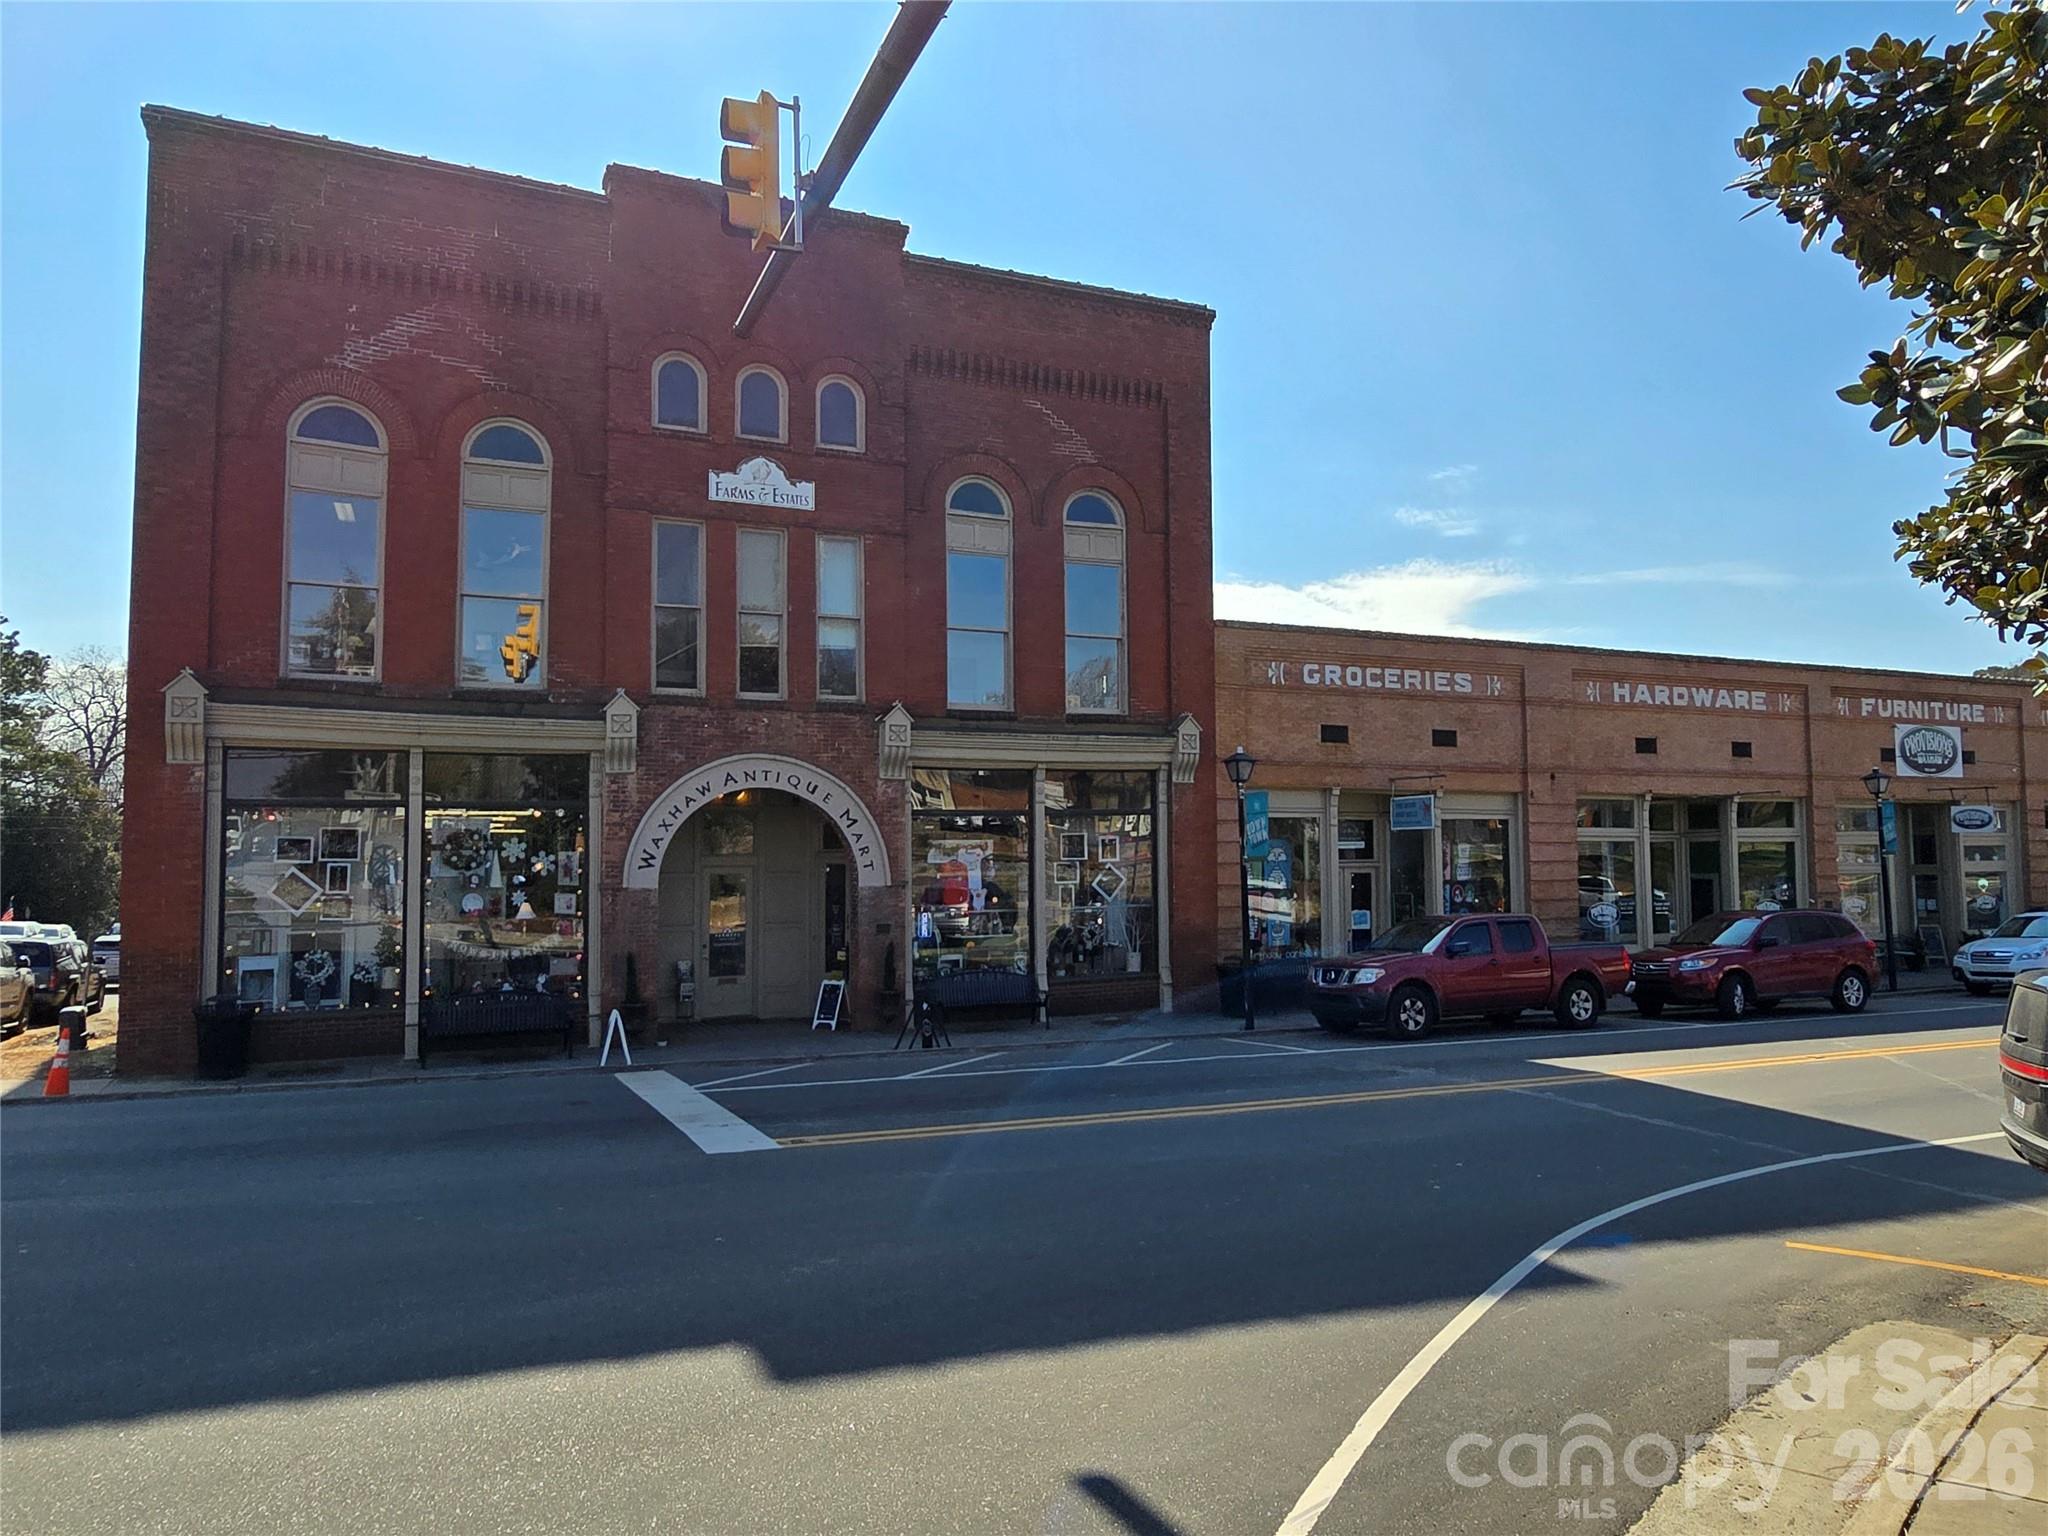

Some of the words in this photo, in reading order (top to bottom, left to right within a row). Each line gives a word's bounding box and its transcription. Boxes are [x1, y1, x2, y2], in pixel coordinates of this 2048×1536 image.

[758, 487, 771, 501] &
[1303, 663, 1473, 693] GROCERIES
[1612, 681, 1767, 711] HARDWARE
[1861, 697, 1985, 723] FURNITURE
[1904, 729, 1954, 758] PROVISIONS
[638, 781, 712, 871] WAXHAW
[724, 769, 834, 805] ANTIQUE
[839, 808, 876, 872] MART
